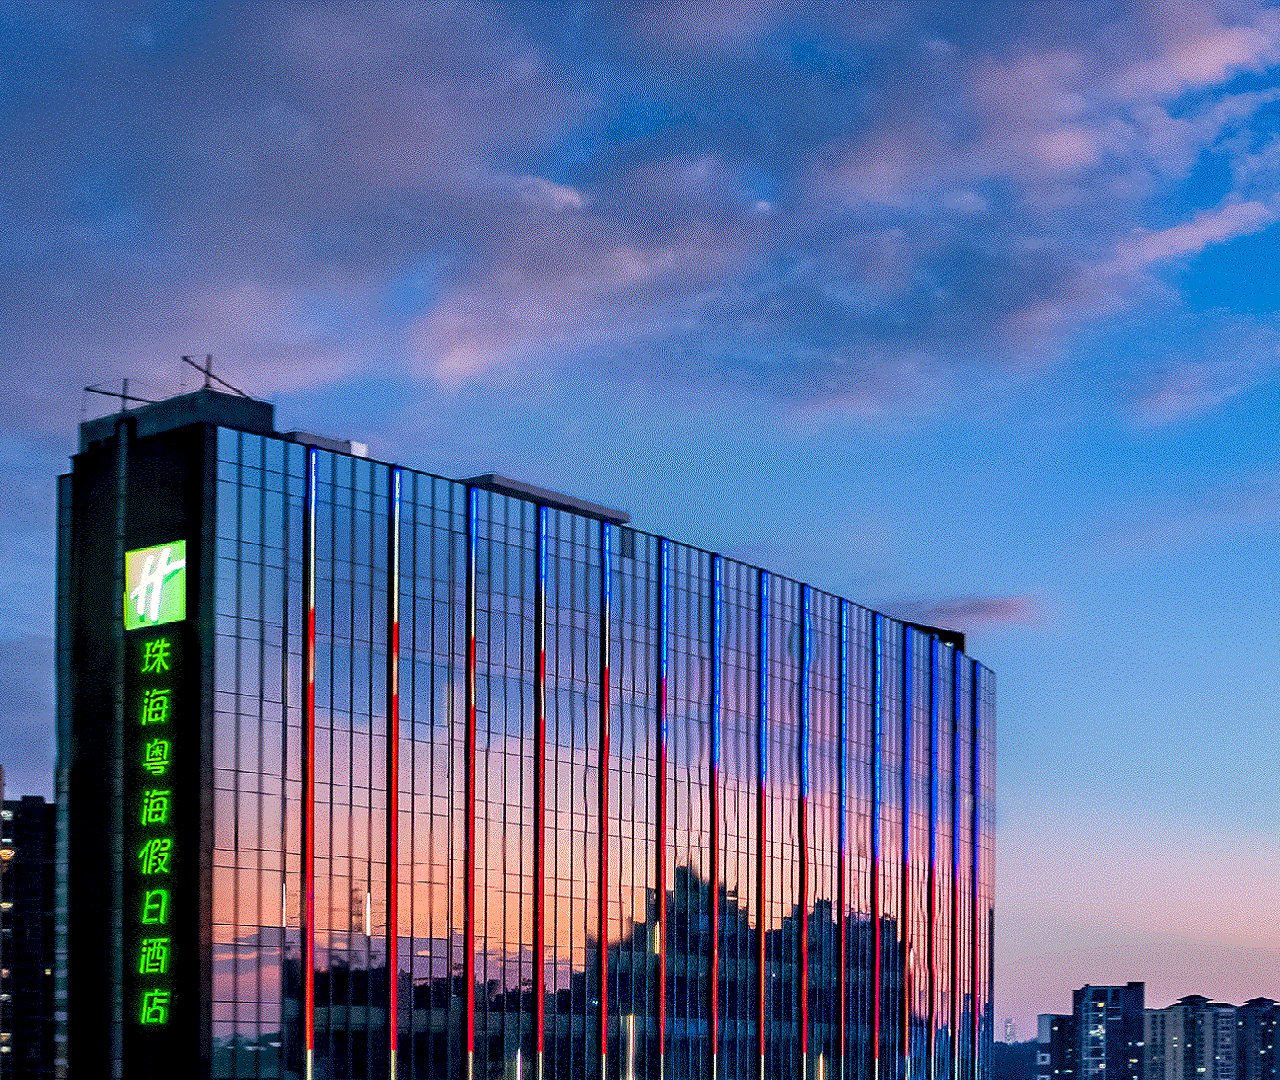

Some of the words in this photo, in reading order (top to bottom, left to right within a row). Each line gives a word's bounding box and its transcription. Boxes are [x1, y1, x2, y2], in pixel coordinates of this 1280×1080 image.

[138, 637, 172, 1024] 珠海粤海假日酒店
